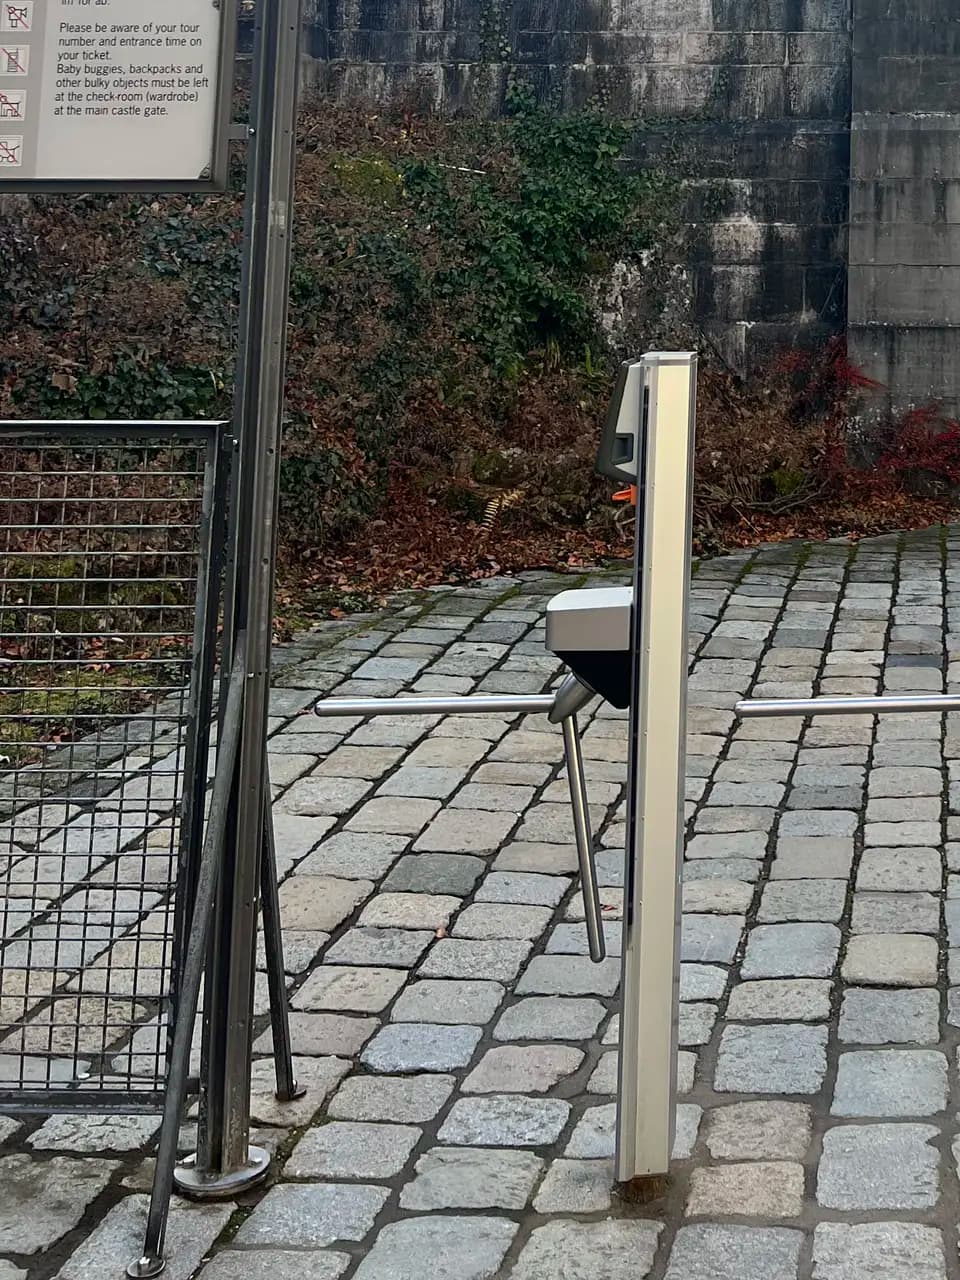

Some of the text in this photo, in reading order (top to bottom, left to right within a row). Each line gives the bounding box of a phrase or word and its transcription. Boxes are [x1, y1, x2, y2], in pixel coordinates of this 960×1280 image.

[60, 22, 199, 34] Please be aware of your tour
[59, 37, 201, 46] number and entrance time on
[58, 50, 112, 62] your ticket.
[57, 64, 203, 76] Baby buggies, backpacks and
[56, 78, 208, 89] other bulky objects must be left
[55, 92, 198, 102] at the check-room (wardrobe)
[54, 106, 168, 117] at the main castle gate.
